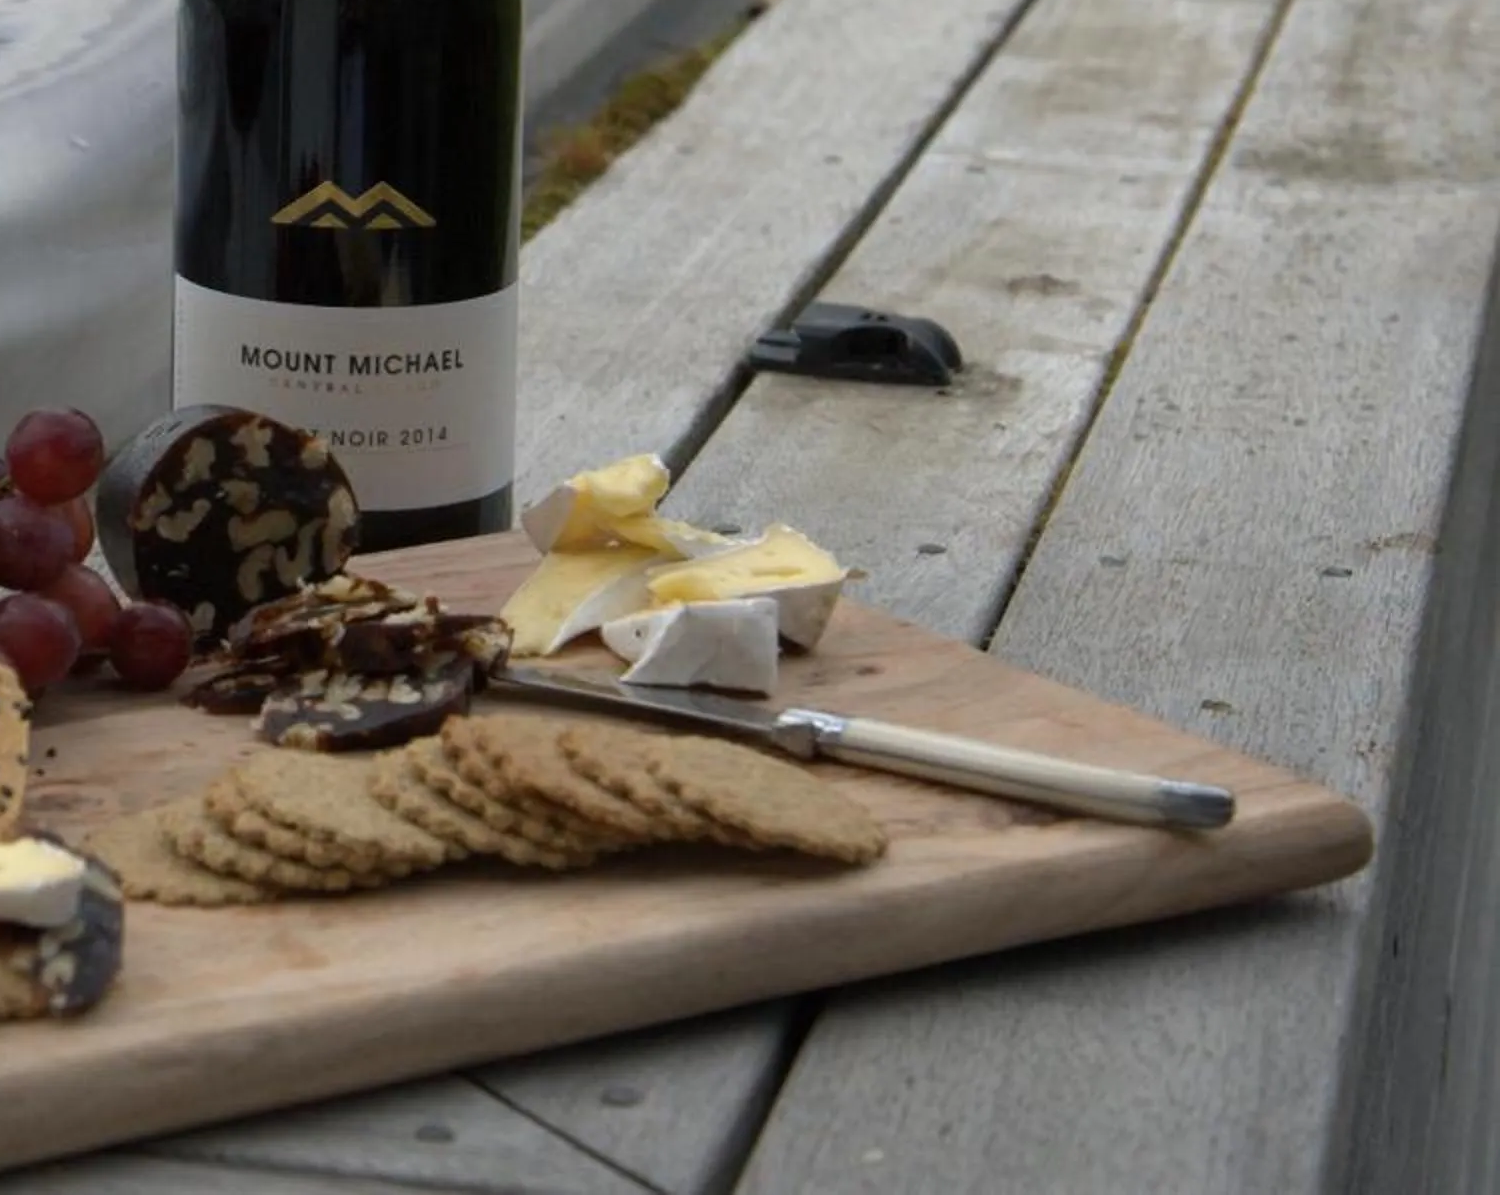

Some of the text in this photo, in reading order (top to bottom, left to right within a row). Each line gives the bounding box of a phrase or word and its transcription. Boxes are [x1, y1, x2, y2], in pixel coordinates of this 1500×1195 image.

[241, 345, 464, 376] MOUNT MICHAEL
[331, 429, 388, 447] NOIR
[400, 426, 447, 447] 2014
